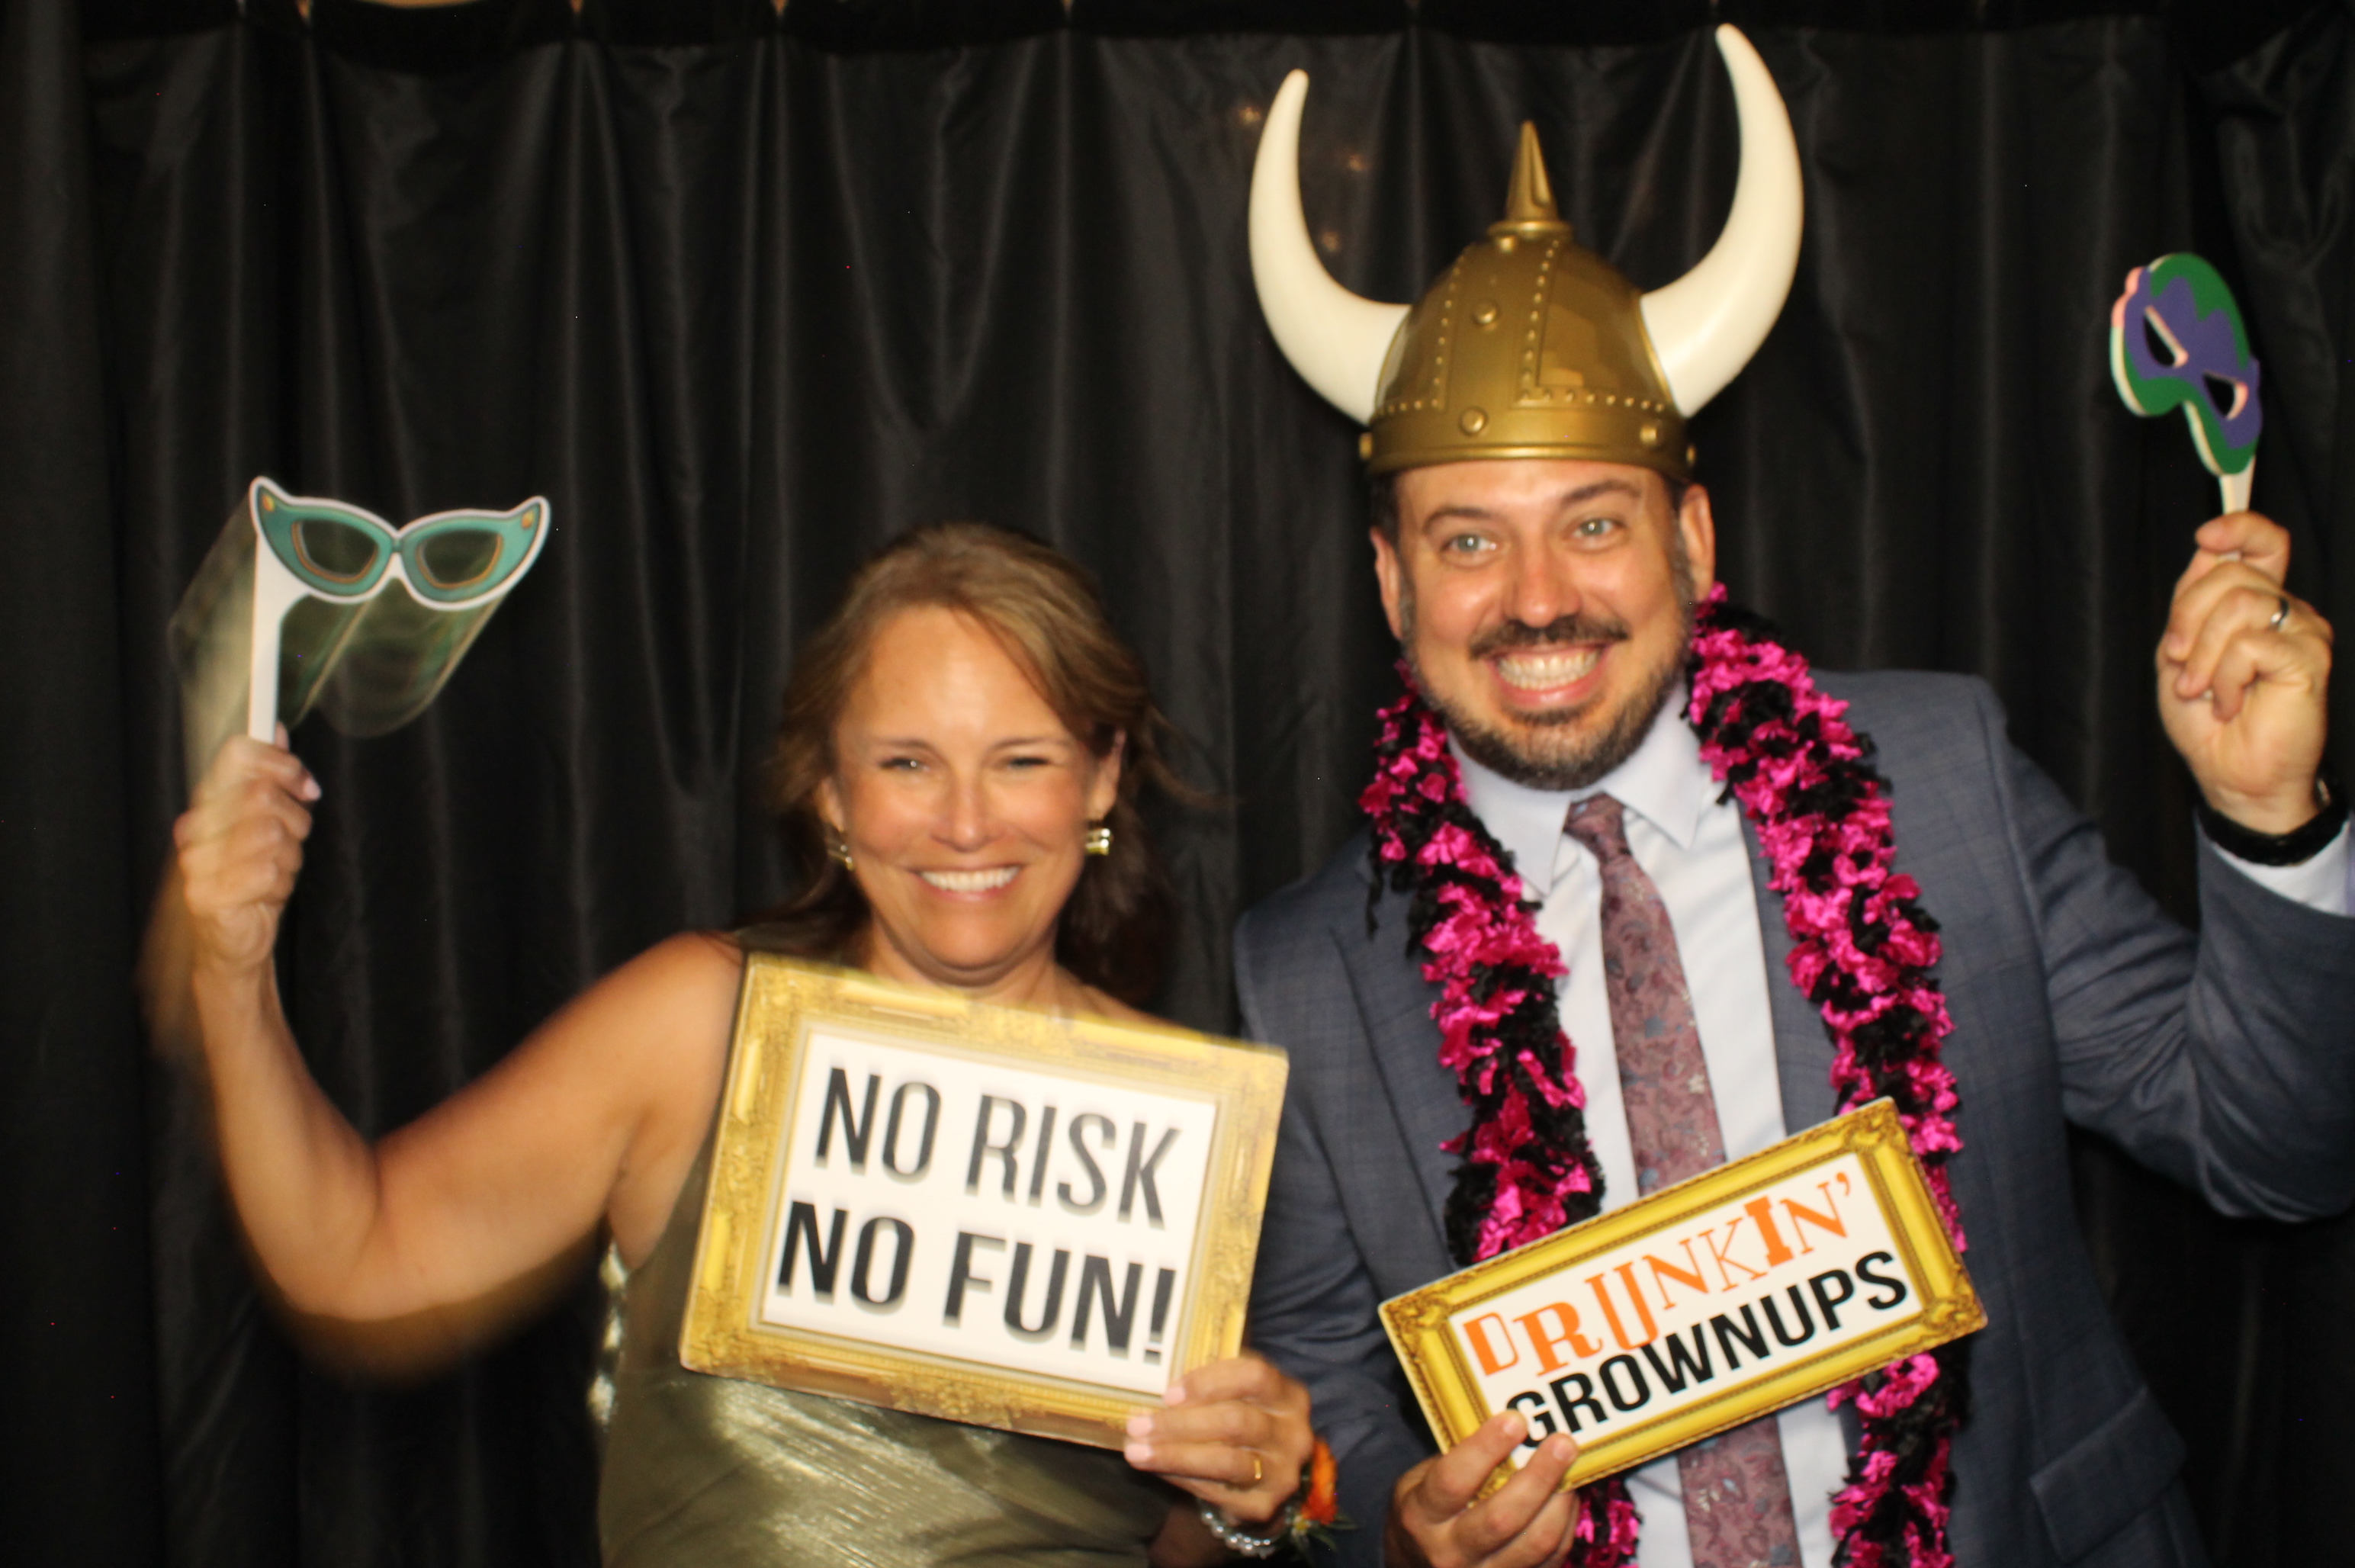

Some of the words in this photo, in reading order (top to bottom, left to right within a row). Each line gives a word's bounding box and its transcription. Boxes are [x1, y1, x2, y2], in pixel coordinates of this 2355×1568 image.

[814, 1067, 941, 1184] NO
[964, 1093, 1181, 1230] RISK
[775, 1199, 915, 1313] NO
[942, 1229, 1177, 1365] FUN!
[1506, 1251, 1908, 1450] GROWNUPS
